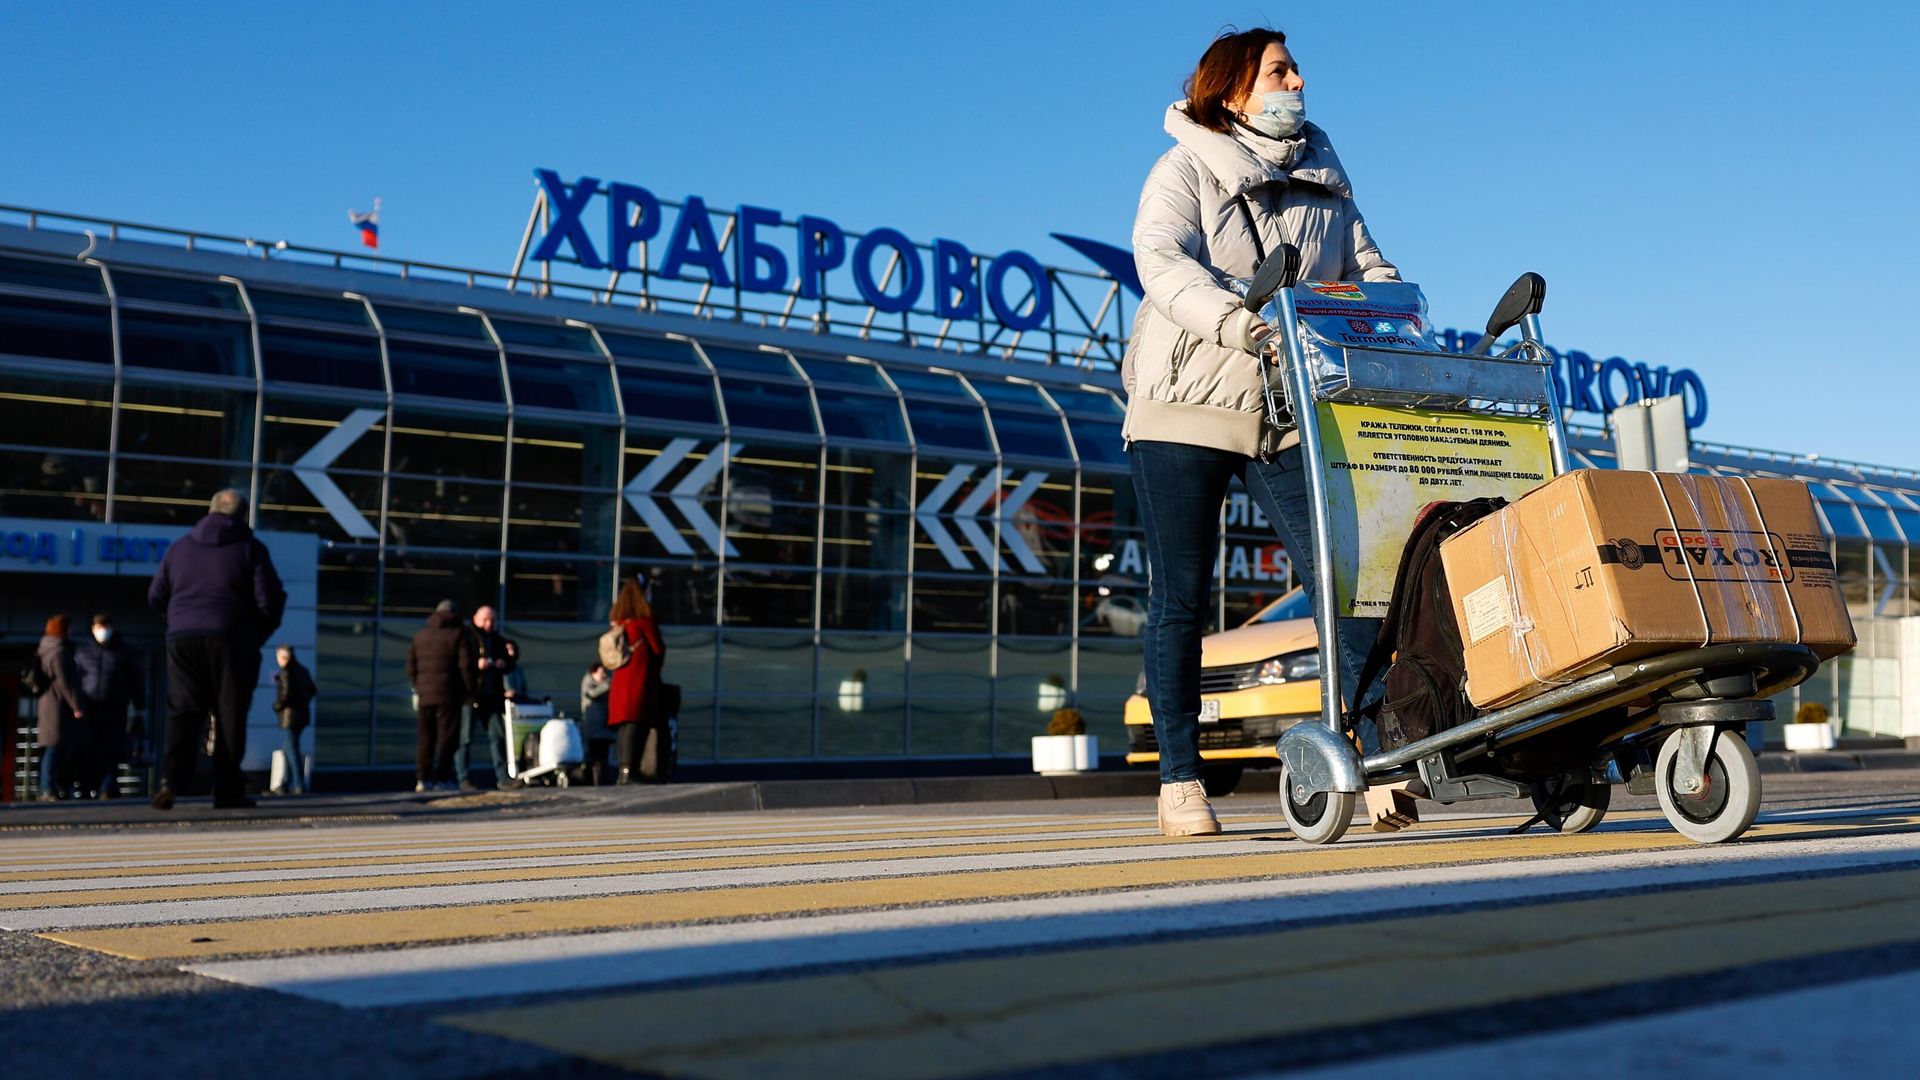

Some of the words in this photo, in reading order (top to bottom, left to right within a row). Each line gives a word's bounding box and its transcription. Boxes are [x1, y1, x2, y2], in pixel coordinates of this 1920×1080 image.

[531, 168, 1052, 332] ХРАБРОВО
[1340, 332, 1419, 347] Termopack
[1361, 421, 1387, 429] КРАЖА
[1388, 423, 1423, 432] ТЕЛЕЖКИ,
[1424, 425, 1459, 434] СОГЛАСНО
[1494, 430, 1507, 438] РФ,
[1357, 431, 1393, 440] ЯВЛЯЕТСЯ
[1393, 433, 1429, 442] УГОЛОВНО
[1479, 439, 1512, 447] ДЕЯНИЕМ.
[1373, 452, 1437, 462] ОТВЕТСТВЕННОСТЬ
[1437, 456, 1503, 466] ПРЕДУСМАТРИВАЕТ
[1330, 462, 1358, 470] ШТРАФ
[1365, 464, 1397, 472] РАЗМЕРЕ
[1398, 466, 1408, 474] ДО
[1409, 465, 1420, 473] 80
[1421, 466, 1436, 474] 000
[1437, 466, 1464, 475] РУБЛЕЙ
[1464, 469, 1480, 477] ИЛИ
[1480, 470, 1512, 478] ЛИШЕНИЕ
[1512, 472, 1544, 480] СВОБОДЫ
[1419, 477, 1428, 485] ДО
[1664, 546, 1783, 568] ROYAL
